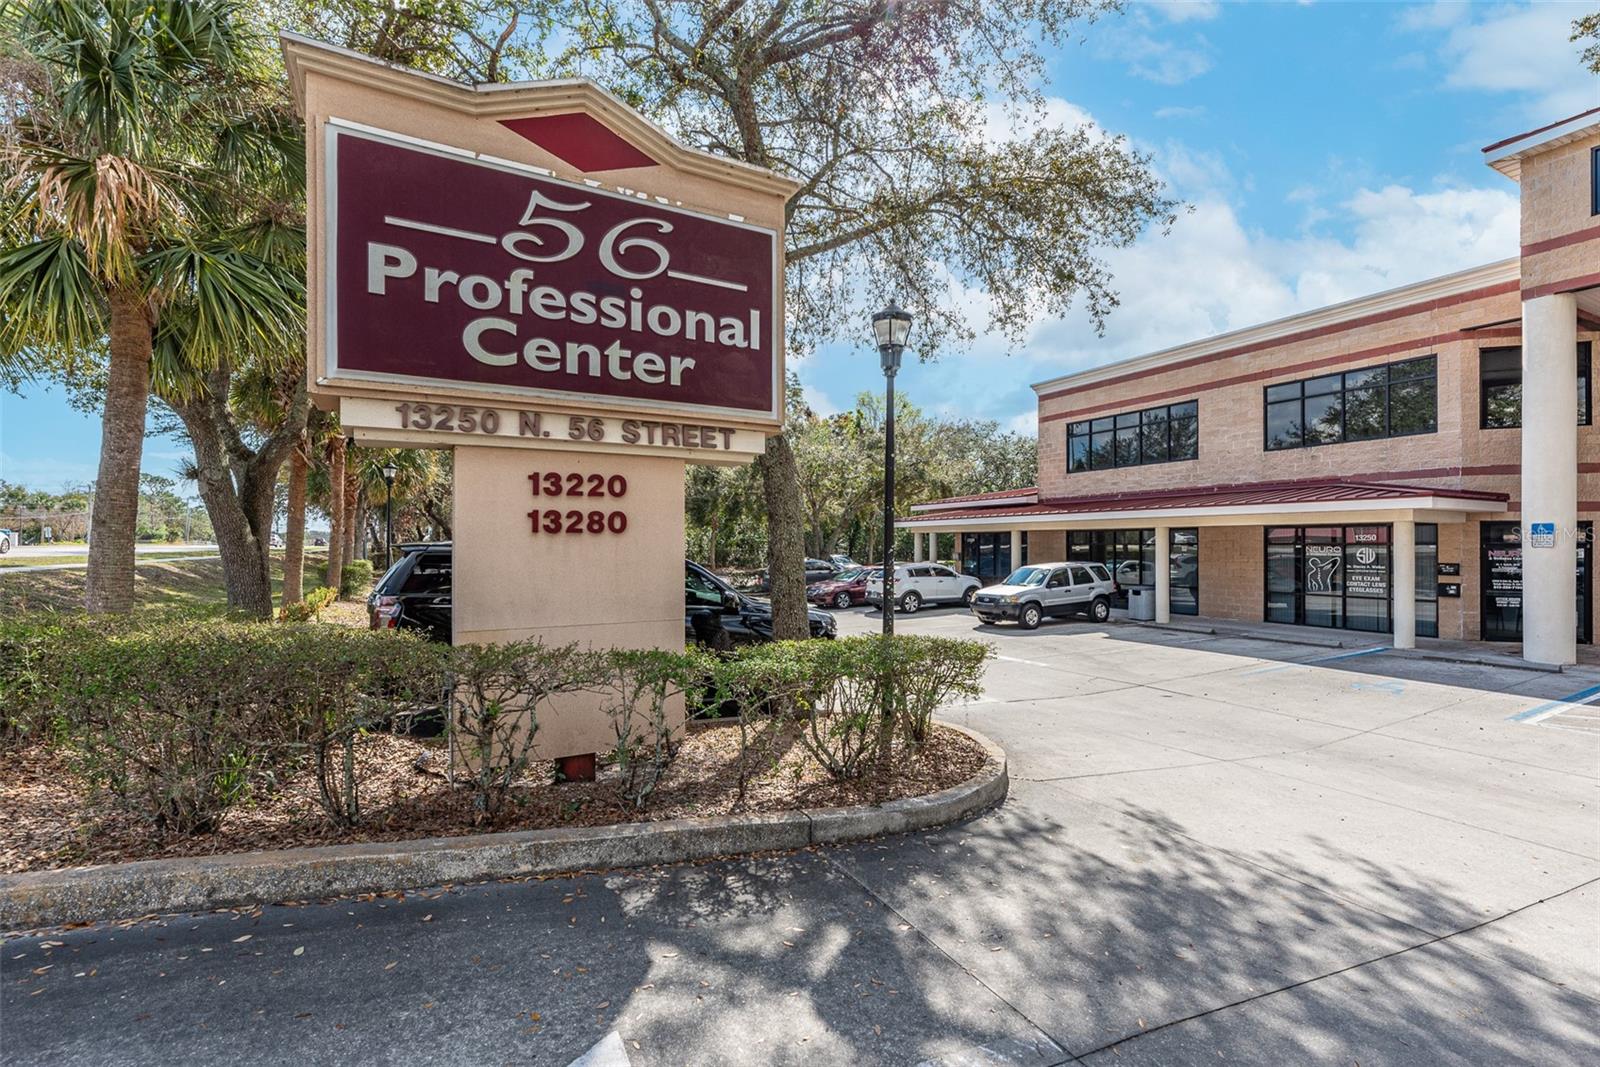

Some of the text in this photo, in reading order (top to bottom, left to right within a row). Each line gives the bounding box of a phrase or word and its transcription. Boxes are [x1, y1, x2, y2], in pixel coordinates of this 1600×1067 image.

[501, 190, 674, 281] 56
[367, 241, 762, 351] Professional
[462, 317, 697, 386] Center
[395, 402, 737, 450] 13250 N. 56 STREET
[527, 471, 628, 499] 13220
[527, 509, 628, 535] 13280
